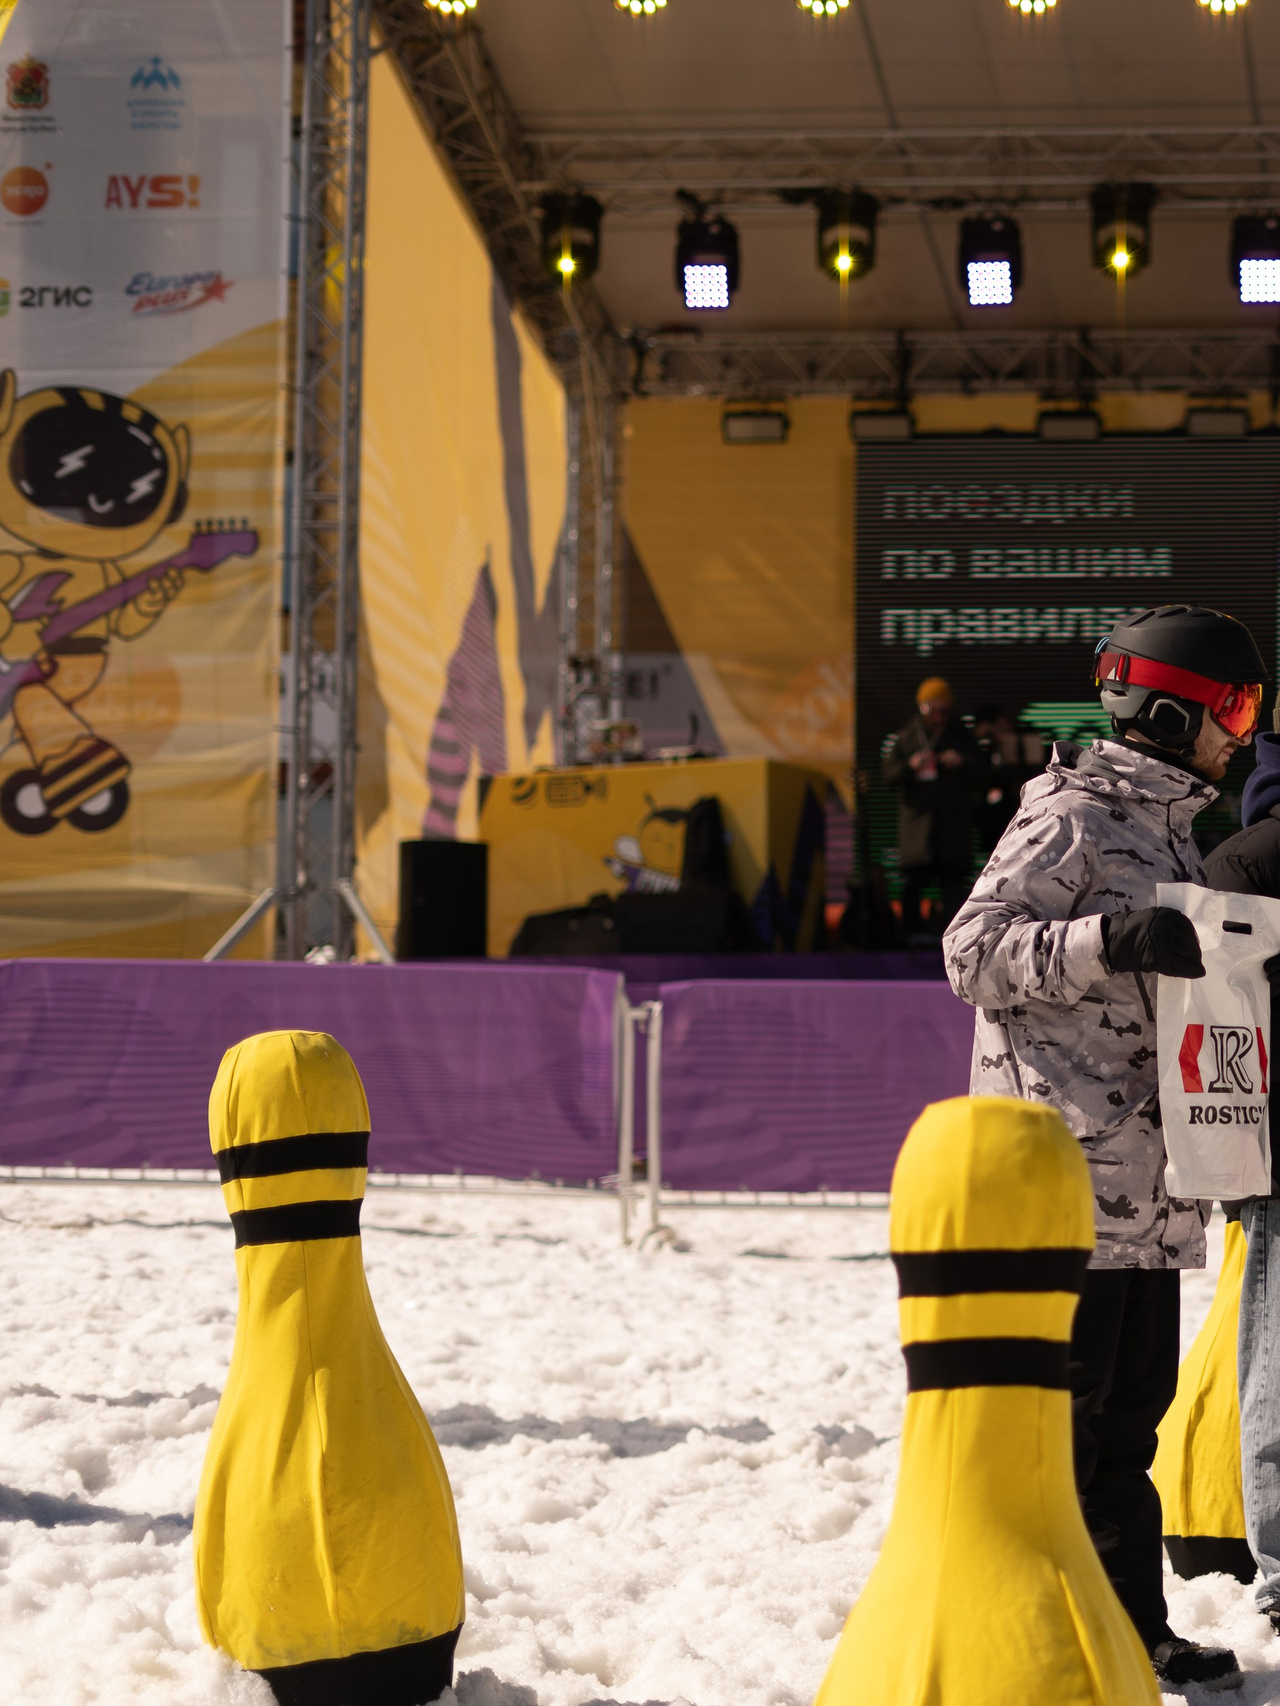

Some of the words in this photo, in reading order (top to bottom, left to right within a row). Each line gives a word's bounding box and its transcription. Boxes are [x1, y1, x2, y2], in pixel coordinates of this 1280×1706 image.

[105, 175, 200, 209] AYS!
[19, 286, 94, 308] 2ГИС
[880, 548, 954, 579] по
[880, 607, 1148, 657] правила
[1209, 1025, 1254, 1094] R
[1188, 1105, 1265, 1125] ROSTIC'
